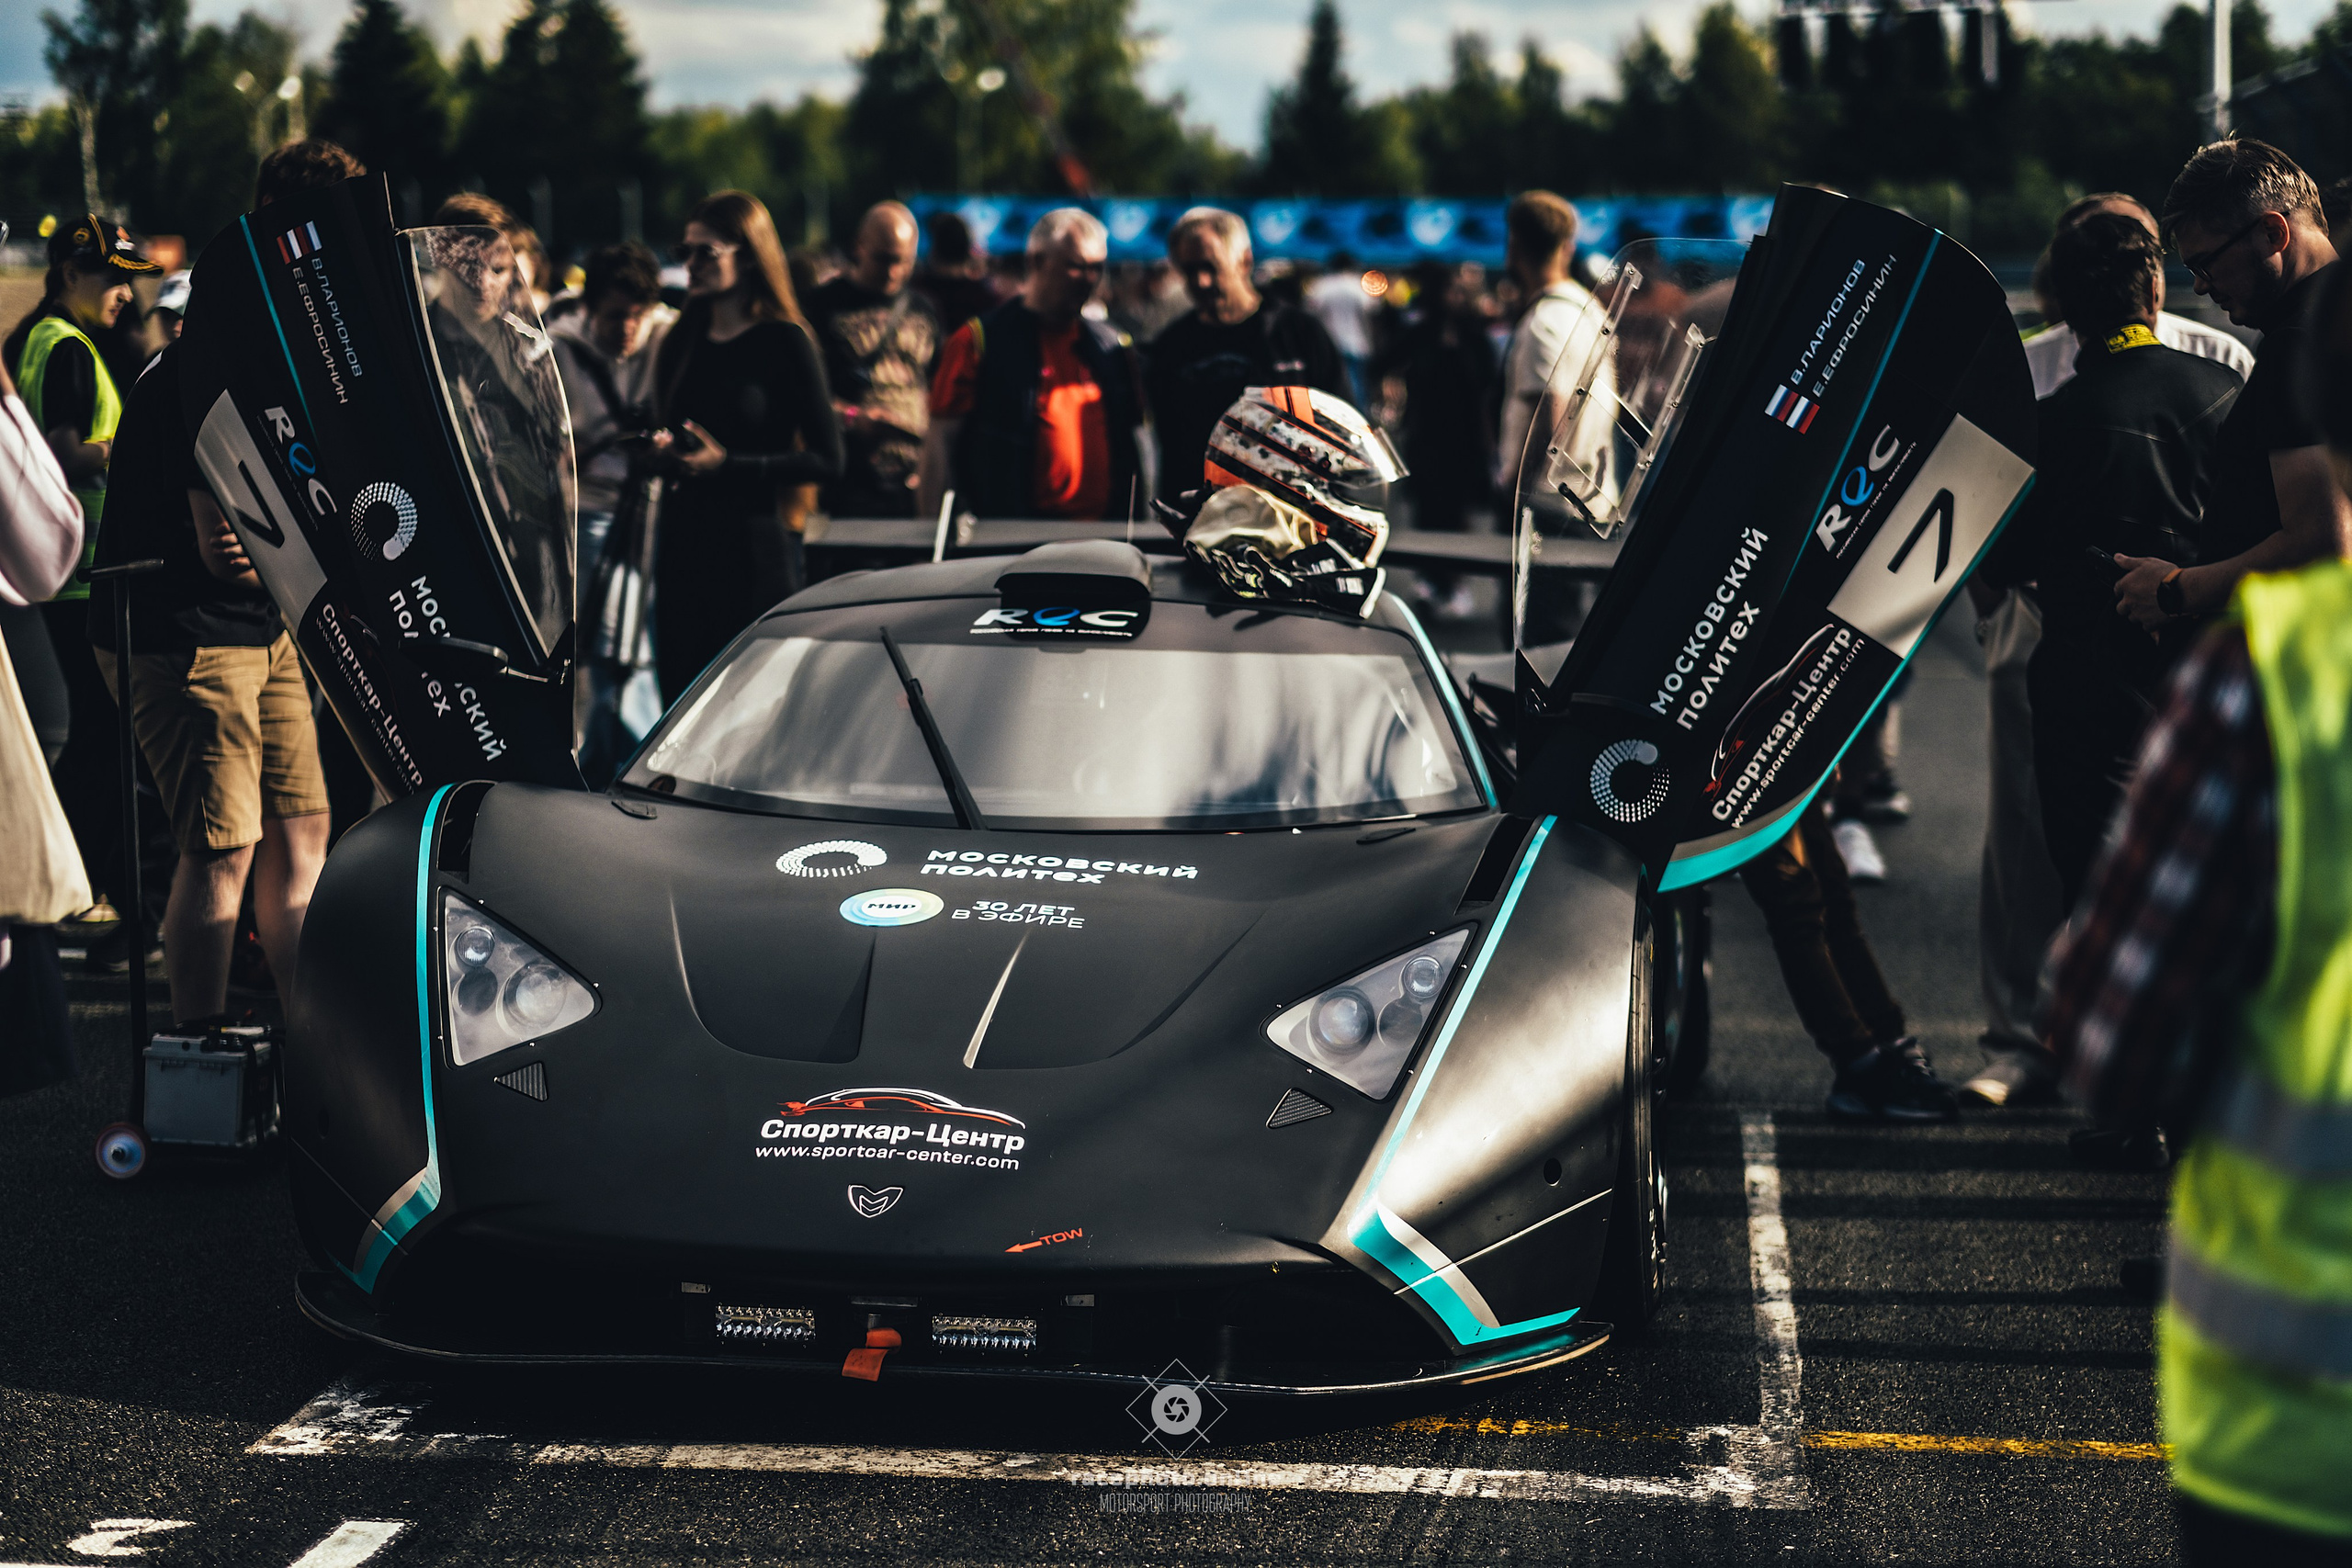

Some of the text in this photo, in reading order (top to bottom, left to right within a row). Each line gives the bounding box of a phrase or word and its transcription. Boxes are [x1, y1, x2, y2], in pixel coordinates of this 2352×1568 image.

[293, 266, 348, 404] Е.ЕФРОСИНИН
[311, 257, 362, 377] В.ЛАРИОНОВ
[1791, 259, 1866, 386] В.ЛАРИОНОВ
[1812, 254, 1897, 397] Е.ЕФРОСИНИН
[233, 459, 285, 548] 7
[1887, 487, 1954, 582] 7
[411, 575, 507, 761] МОССКИЙ
[1650, 526, 1770, 716] МОСКОВСКИЙ
[322, 604, 423, 786] Спорткар-Центр
[1712, 627, 1851, 821] Спорткар-Центр
[1731, 637, 1866, 829] www.sportcar-center.com
[927, 850, 1199, 879] МОСКОВСКИЙ
[951, 908, 1086, 930] В ЭФИРЕ
[972, 900, 1076, 917] 30 ЛЕТ
[754, 1144, 1020, 1171] www.sportcar-center.com
[760, 1119, 1026, 1155] Спорткар-Центр
[1039, 1227, 1083, 1247] TOW
